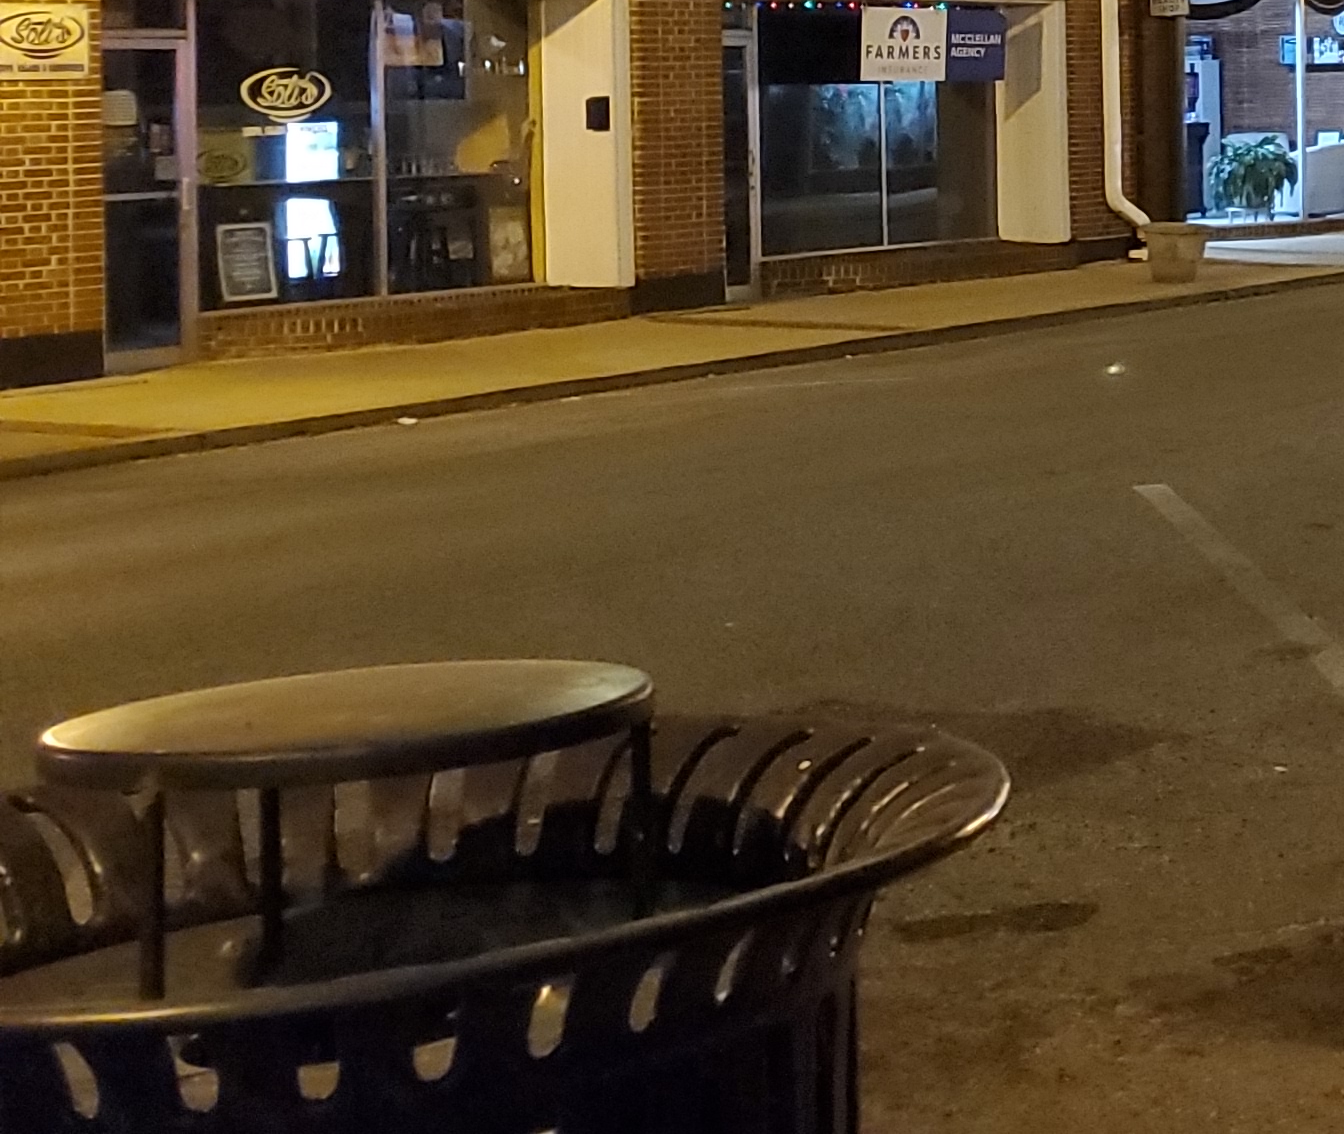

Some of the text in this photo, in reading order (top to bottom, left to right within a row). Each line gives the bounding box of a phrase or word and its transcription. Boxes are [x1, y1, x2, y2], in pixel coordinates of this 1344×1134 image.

[951, 33, 1002, 45] MCCLELLAN
[865, 44, 942, 61] FARMERS
[950, 47, 986, 58] AGENCY
[877, 65, 928, 74] INSURANCE
